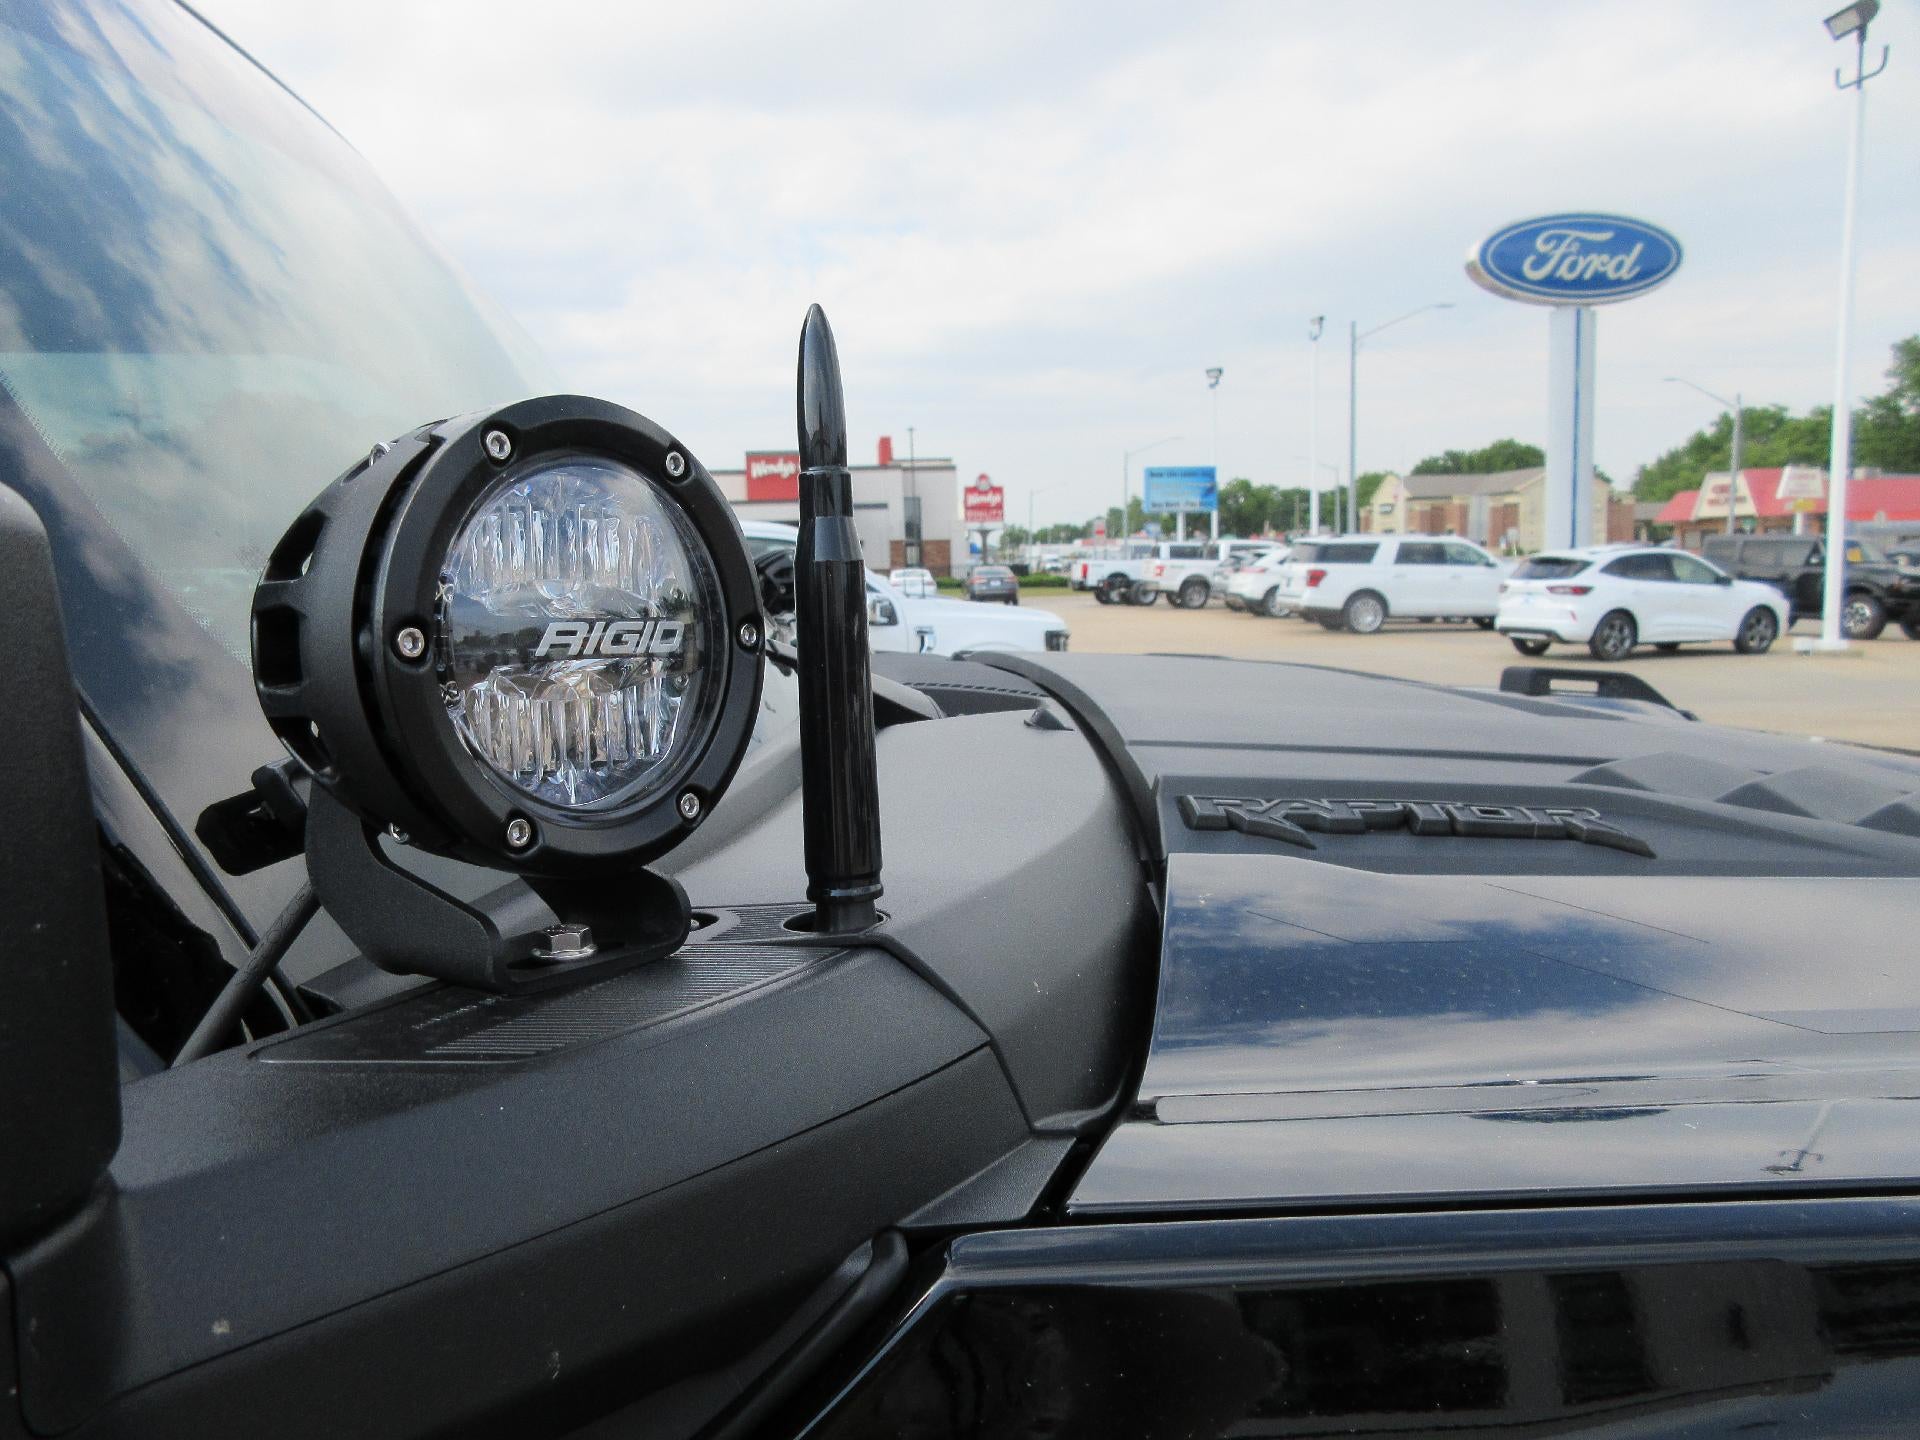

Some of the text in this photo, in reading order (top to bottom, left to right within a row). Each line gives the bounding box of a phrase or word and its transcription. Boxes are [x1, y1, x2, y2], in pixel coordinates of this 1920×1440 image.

[1522, 229, 1644, 281] Ford
[534, 620, 685, 657] RIGID
[1179, 795, 1657, 859] RAPTOR
